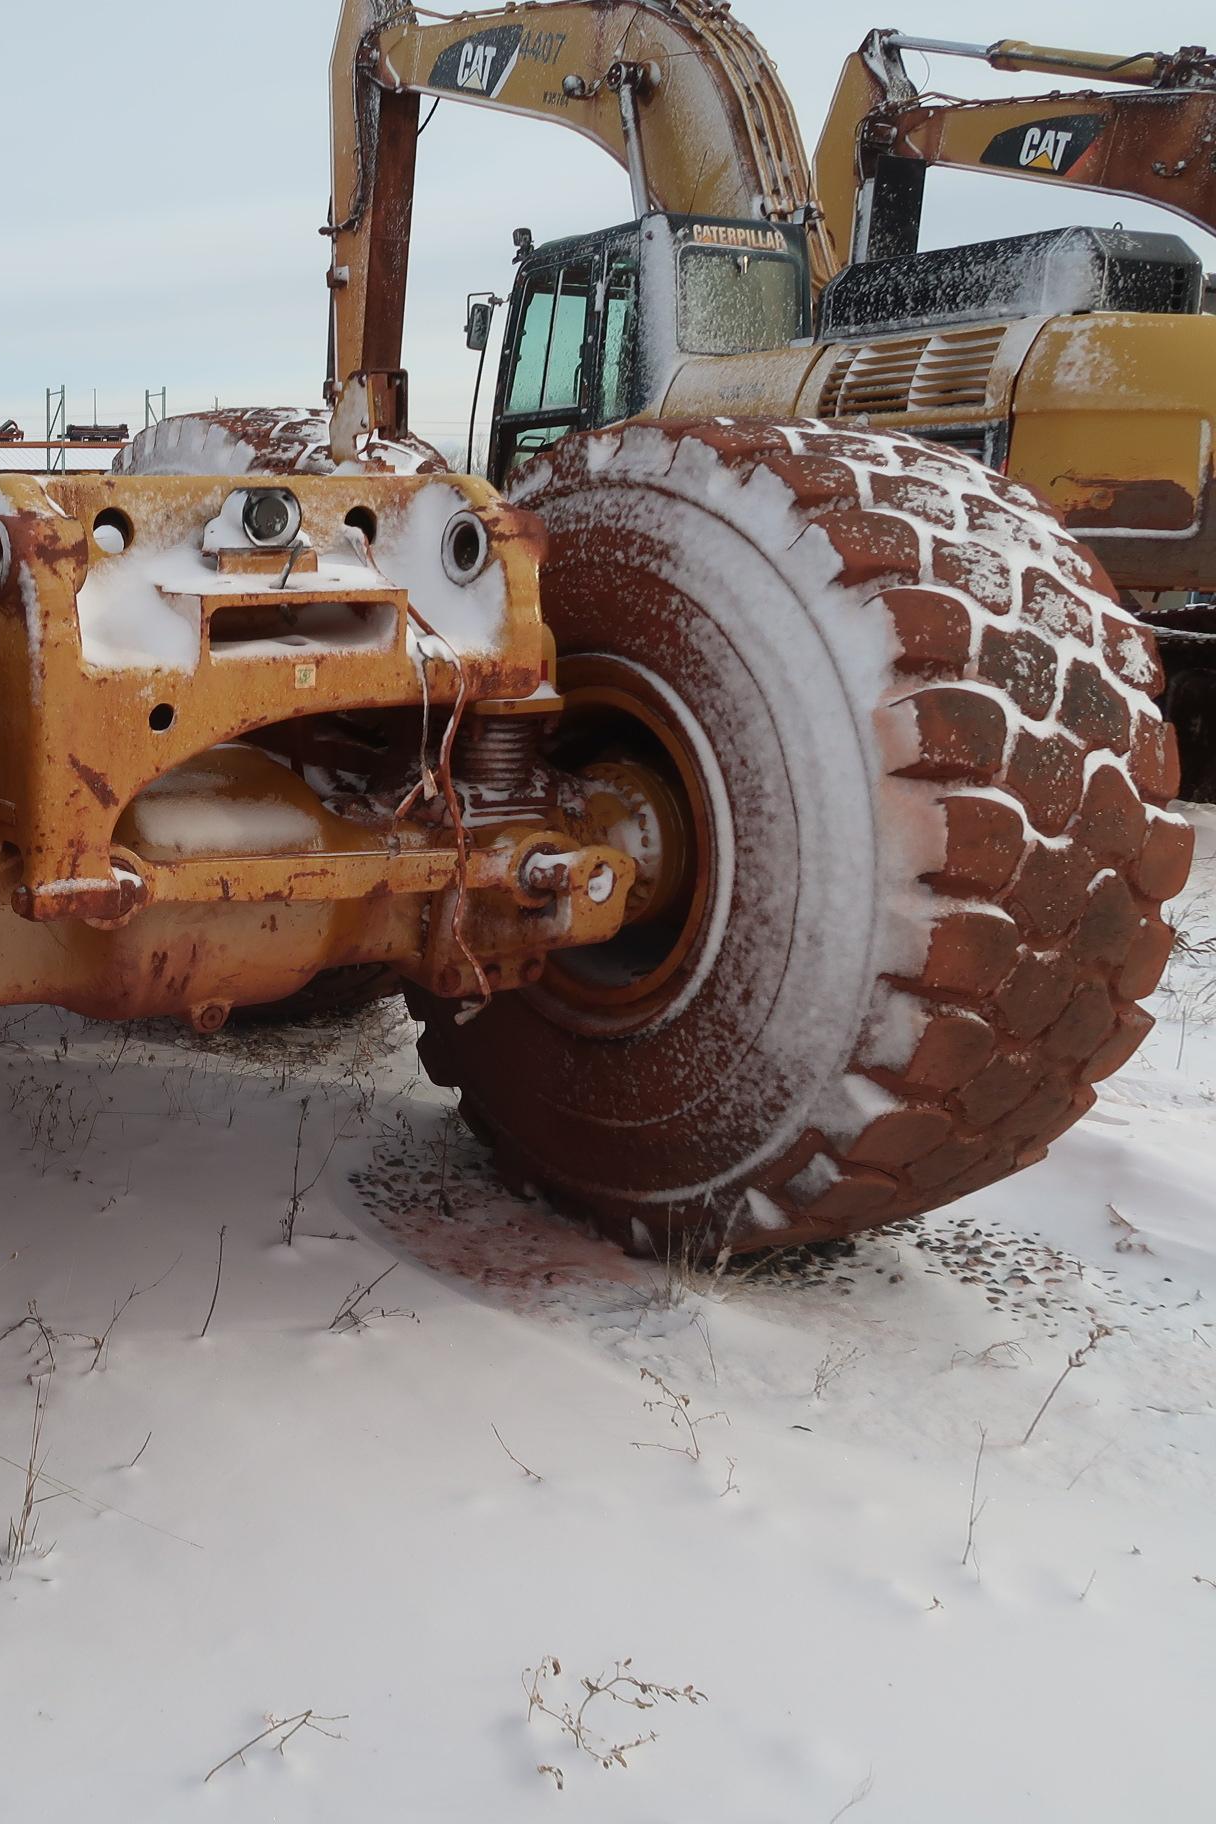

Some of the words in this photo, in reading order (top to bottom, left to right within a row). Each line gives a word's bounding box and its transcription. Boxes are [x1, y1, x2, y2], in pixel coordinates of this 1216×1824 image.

[457, 42, 497, 91] CAT
[1019, 127, 1072, 171] CAT
[693, 224, 785, 250] CATERPILLAR
